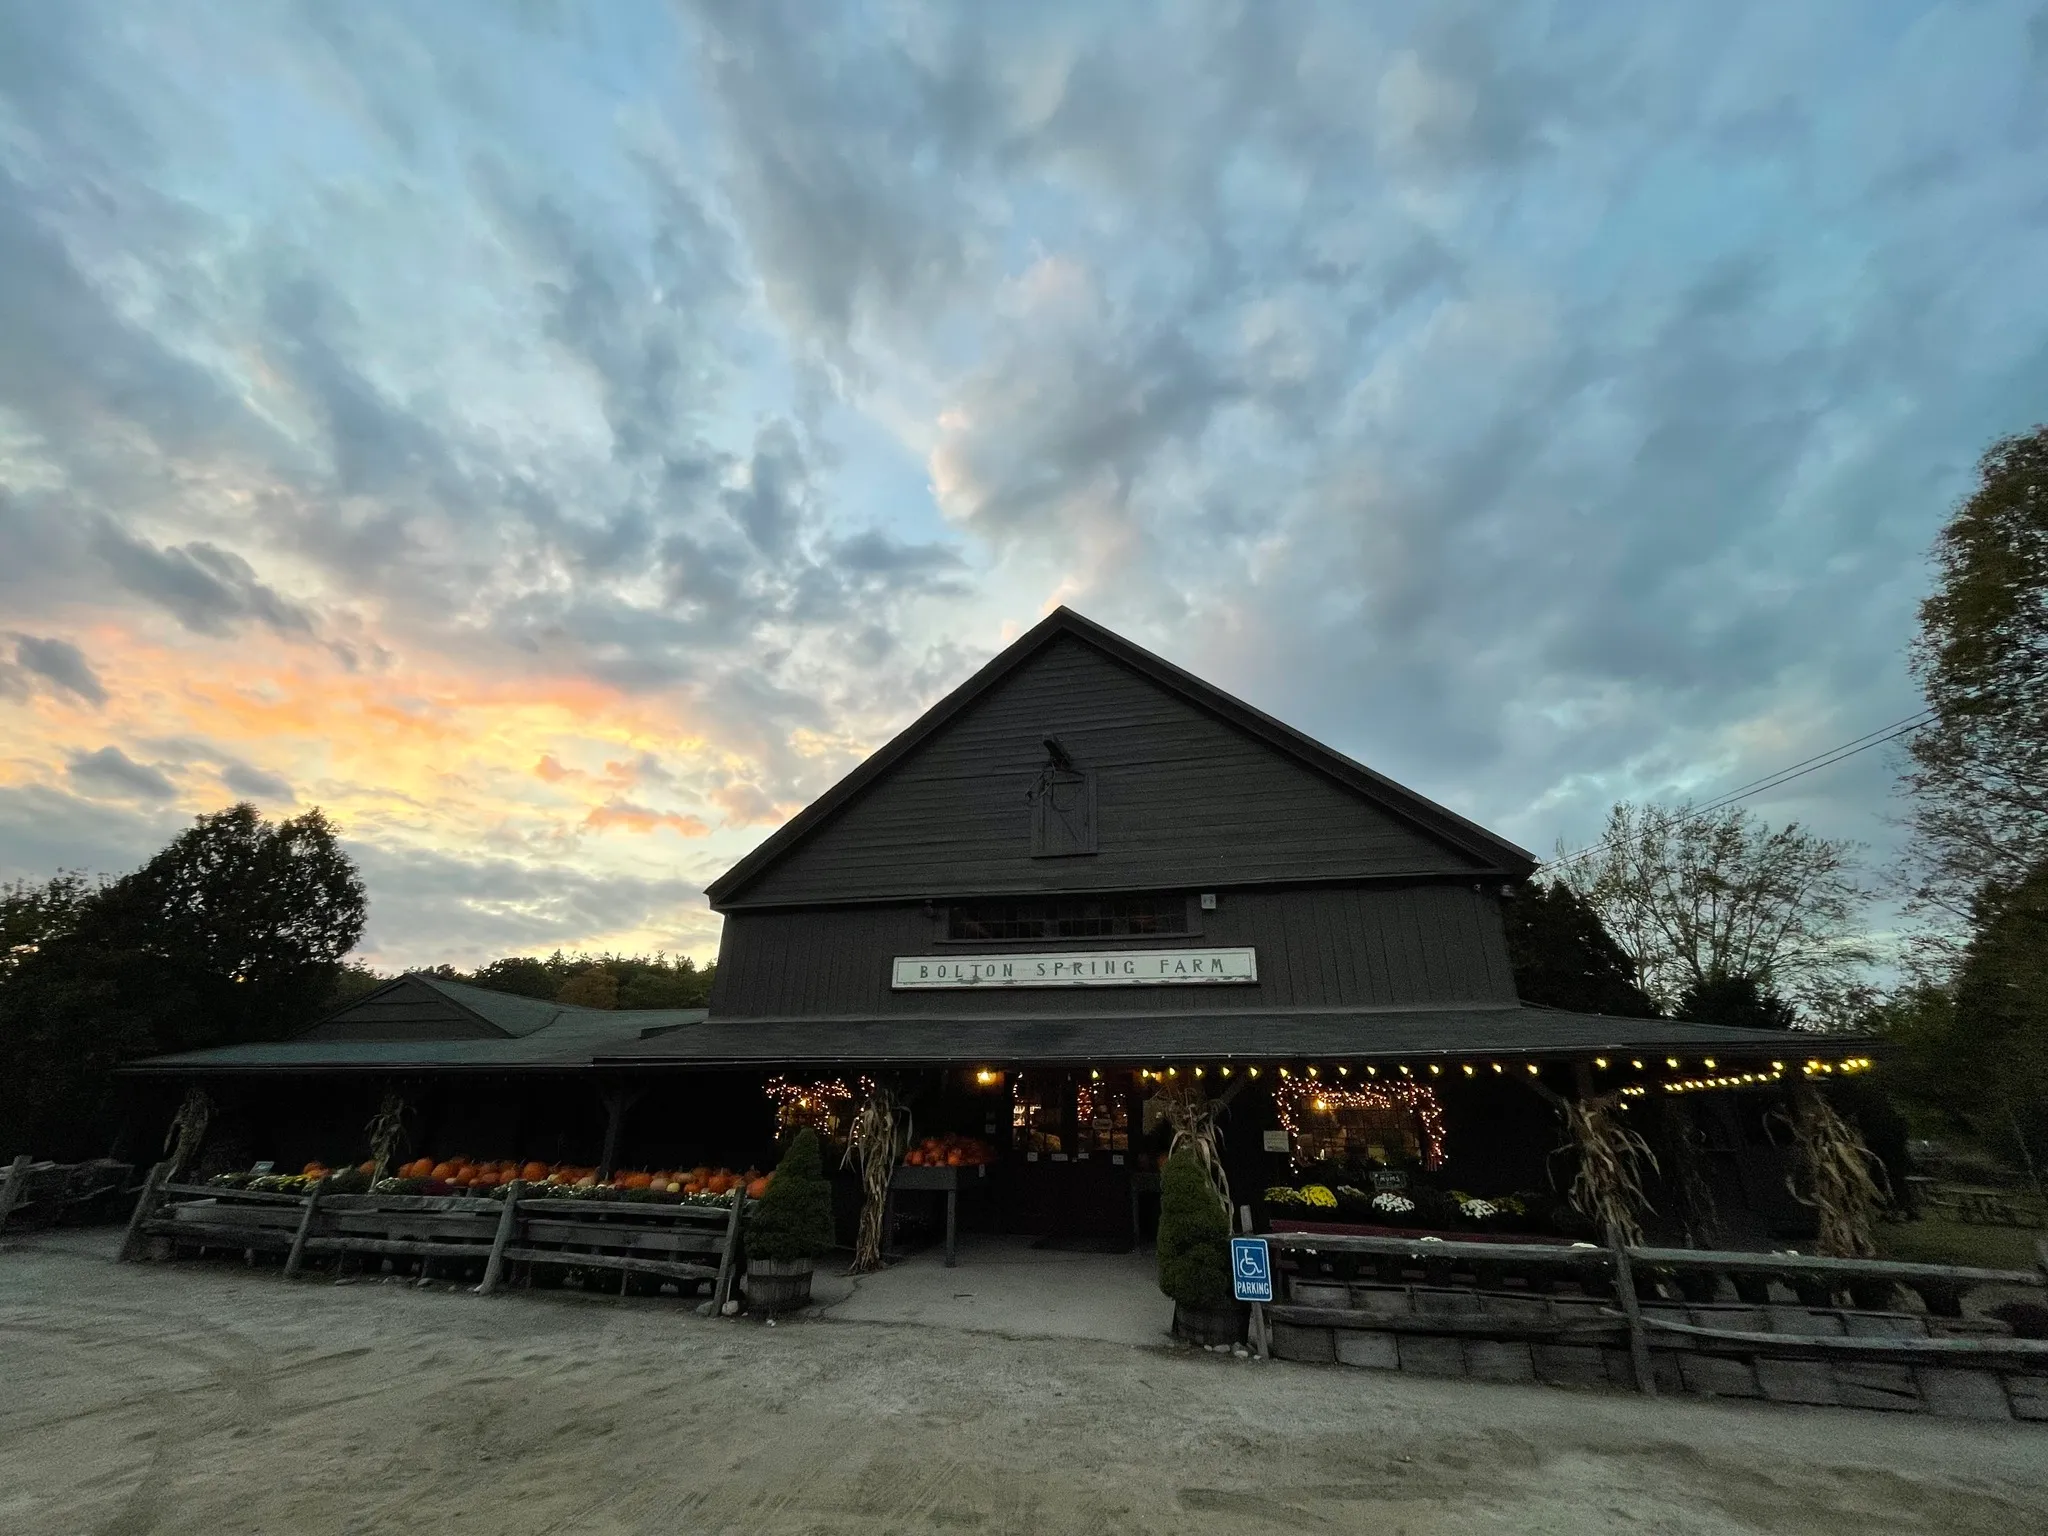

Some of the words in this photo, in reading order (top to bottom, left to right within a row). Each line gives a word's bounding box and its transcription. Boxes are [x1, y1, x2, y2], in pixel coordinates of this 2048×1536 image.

[920, 963, 1013, 979] BOLTON
[1036, 960, 1135, 977] SPRING
[1160, 958, 1224, 974] FARM
[1237, 1281, 1270, 1295] PARKING
